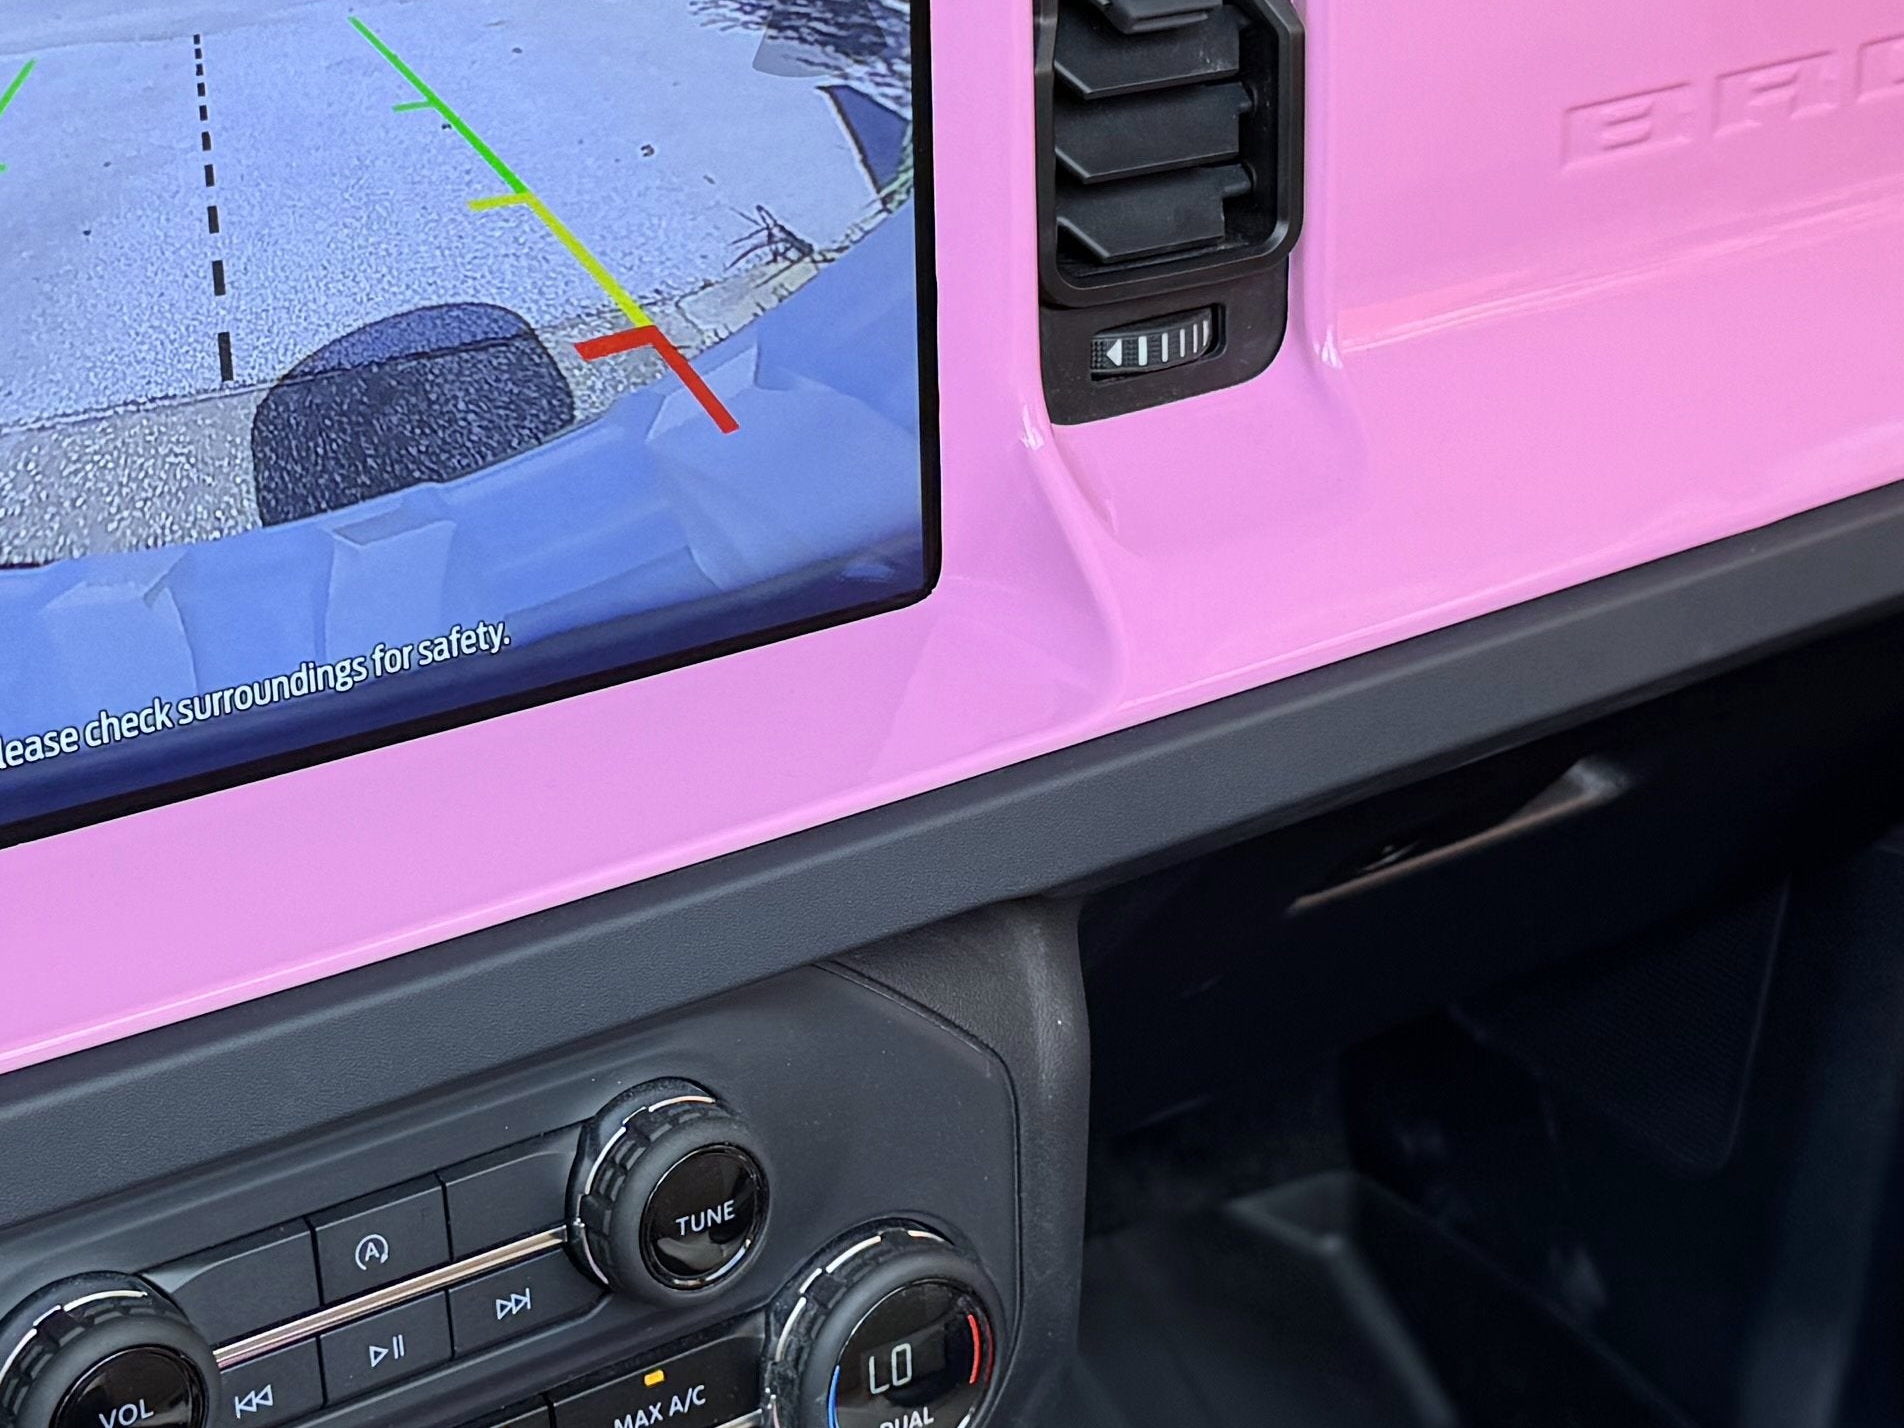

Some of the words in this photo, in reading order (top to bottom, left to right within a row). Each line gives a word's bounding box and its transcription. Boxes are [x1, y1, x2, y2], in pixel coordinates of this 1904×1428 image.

[84, 697, 175, 747] check
[177, 655, 368, 726] surroundings
[371, 640, 414, 677] for
[416, 619, 512, 666] safety.
[676, 1199, 736, 1236] TUNE
[365, 1241, 380, 1262] A
[868, 1342, 912, 1394] LO
[668, 1384, 706, 1417] A/C
